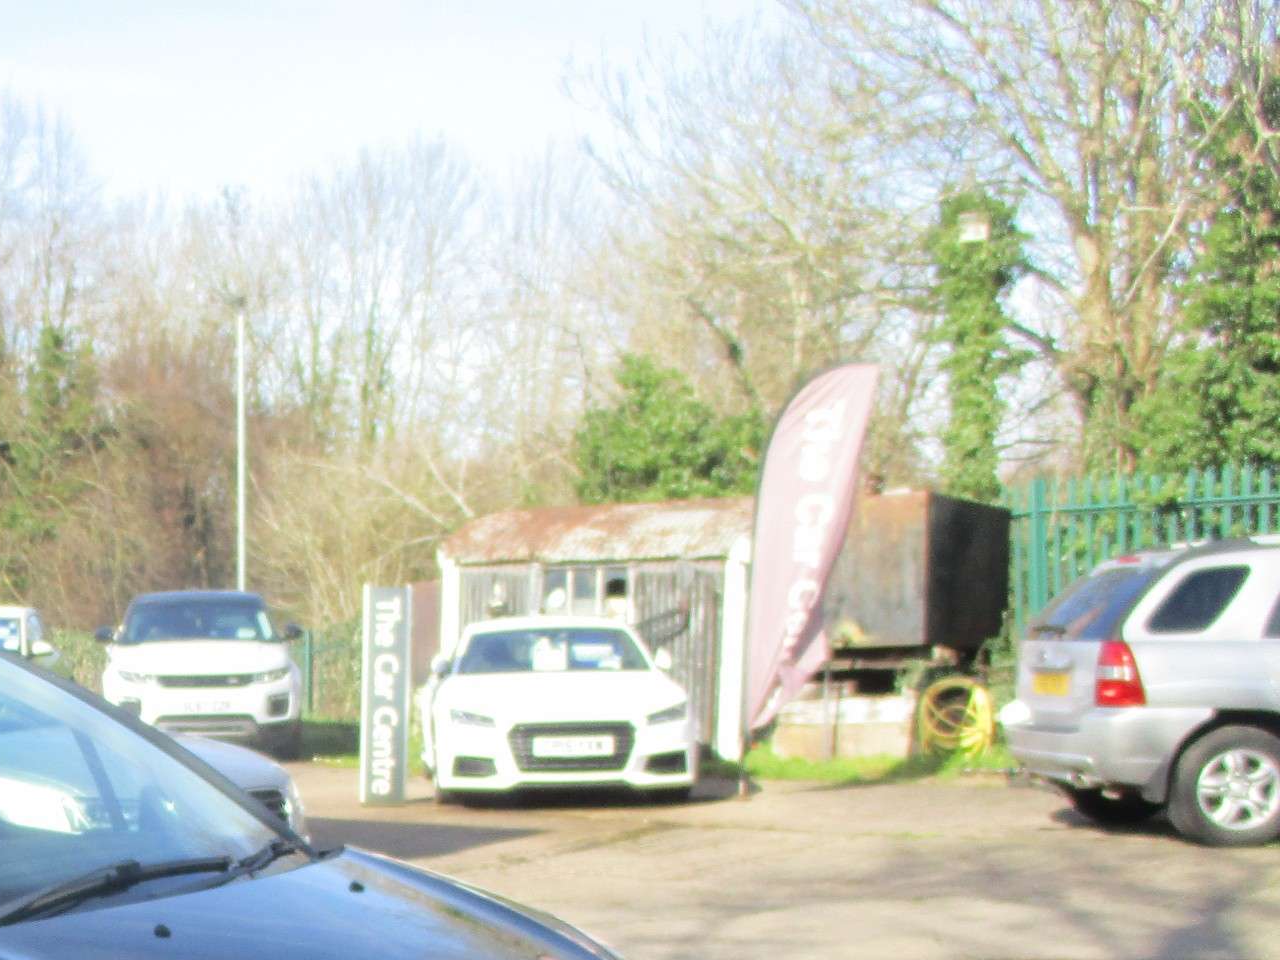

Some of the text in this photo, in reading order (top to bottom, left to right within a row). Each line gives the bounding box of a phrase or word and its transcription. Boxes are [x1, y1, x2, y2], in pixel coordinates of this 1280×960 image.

[371, 595, 402, 796] The Car Centre
